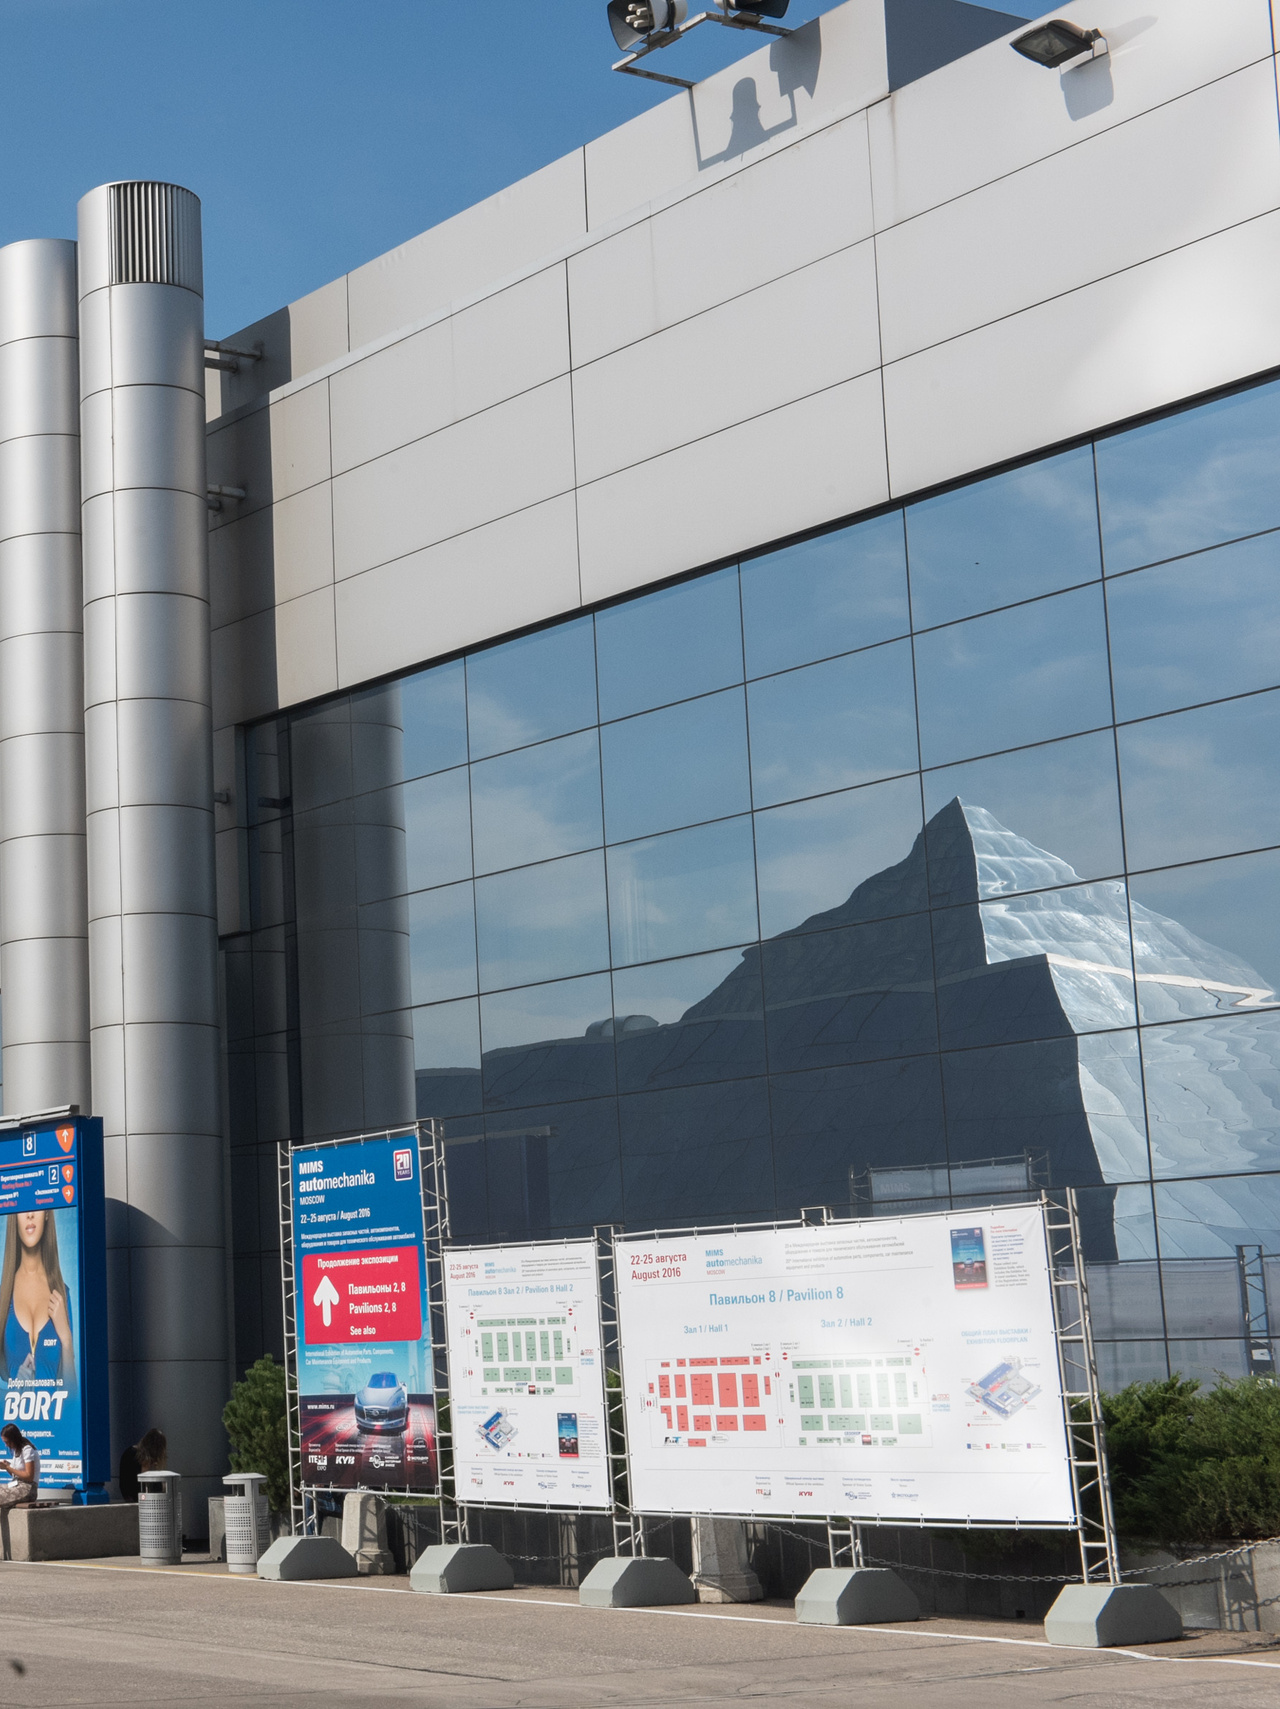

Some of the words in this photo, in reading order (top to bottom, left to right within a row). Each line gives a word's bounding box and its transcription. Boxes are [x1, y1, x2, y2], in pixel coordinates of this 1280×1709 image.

[26, 1136, 32, 1151] 8
[299, 1161, 323, 1174] MIMS
[396, 1153, 409, 1170] 20
[51, 1169, 57, 1180] 2
[299, 1169, 375, 1192] automechanika
[300, 1195, 325, 1205] MOSCOW
[318, 1213, 336, 1223] августа
[340, 1210, 358, 1221] August
[359, 1208, 371, 1218] 2016
[318, 1258, 360, 1270] Продолжение
[361, 1255, 398, 1265] экспозиции
[630, 1254, 653, 1265] 22-25
[655, 1253, 687, 1264] августа
[706, 1256, 763, 1268] automechanika
[462, 1263, 479, 1271] августа
[631, 1270, 660, 1281] August
[662, 1267, 681, 1278] 2016
[348, 1284, 392, 1295] Павильоны
[393, 1282, 400, 1293] 2,
[401, 1282, 406, 1292] 8
[503, 1287, 515, 1295] Зал
[525, 1285, 549, 1294] Pavilion
[556, 1284, 568, 1292] Hall
[709, 1293, 765, 1306] Павильон
[768, 1290, 776, 1303] 8
[779, 1290, 783, 1302] /
[787, 1287, 832, 1302] Pavilion
[836, 1286, 844, 1299] 8
[349, 1302, 382, 1314] Pavilions
[384, 1302, 390, 1313] 2,
[392, 1302, 397, 1312] 8
[821, 1319, 835, 1328] Зал
[837, 1319, 843, 1327] 2
[850, 1318, 865, 1327] Hall
[867, 1317, 873, 1326] 2
[350, 1326, 362, 1336] See
[362, 1325, 376, 1335] also
[683, 1325, 697, 1334] Зал
[699, 1325, 702, 1333] 1
[708, 1324, 723, 1332] Hall
[724, 1324, 728, 1332] 1
[7, 1378, 24, 1389] Добро
[24, 1379, 56, 1388] пожаловать
[56, 1378, 63, 1386] на
[3, 1391, 68, 1420] BORT
[335, 1456, 355, 1464] KYB
